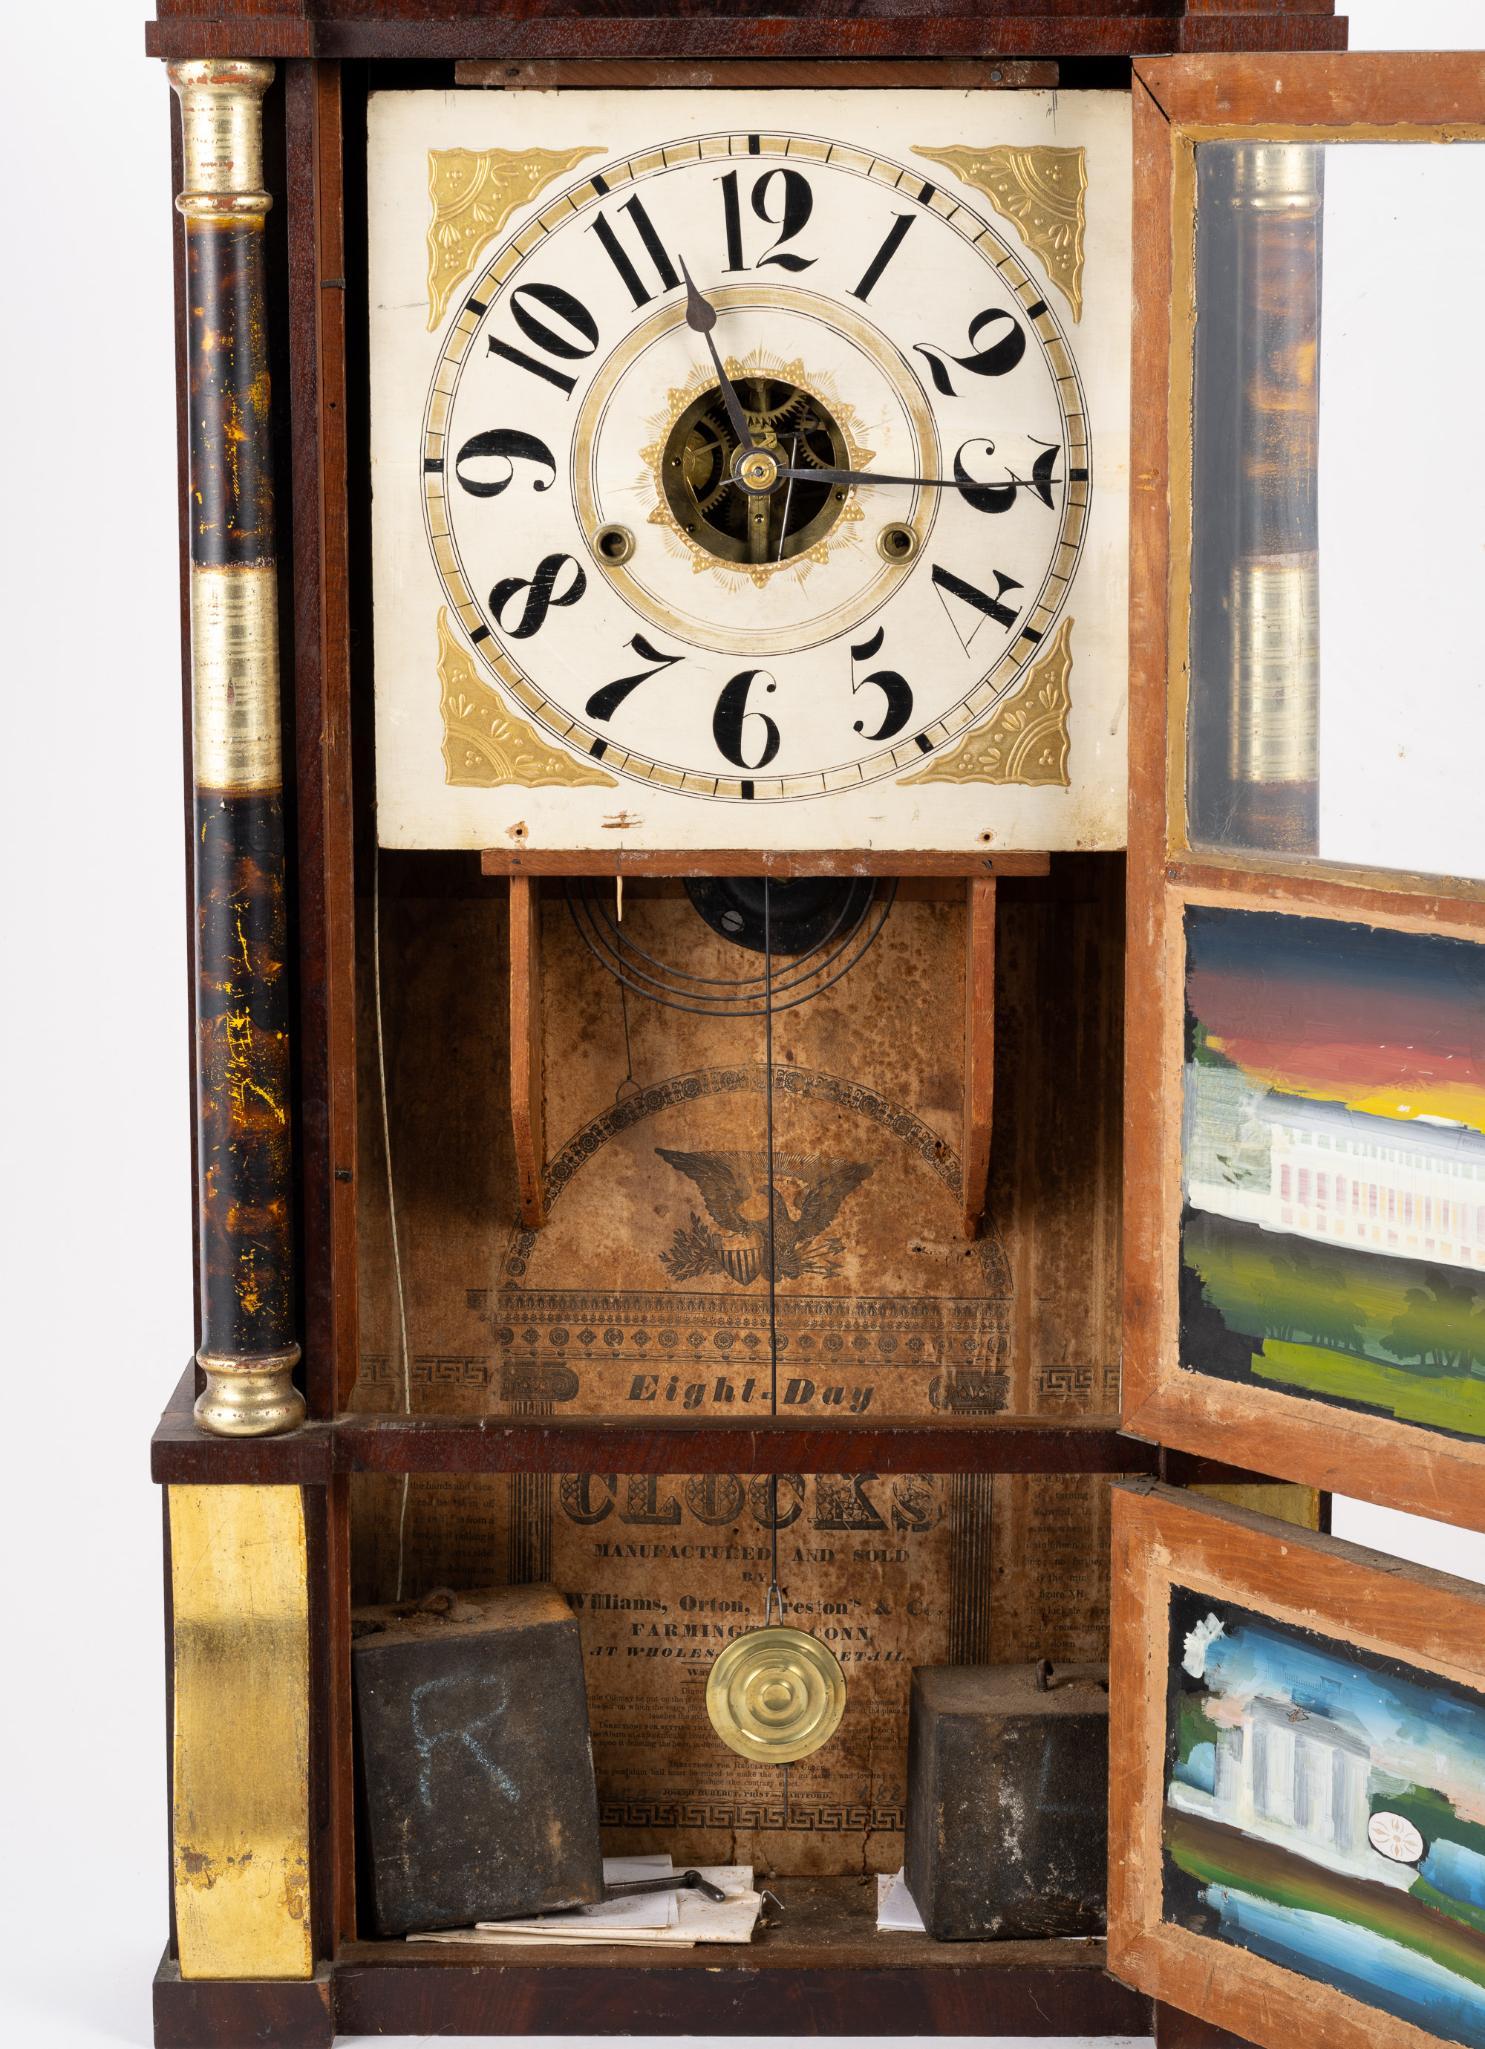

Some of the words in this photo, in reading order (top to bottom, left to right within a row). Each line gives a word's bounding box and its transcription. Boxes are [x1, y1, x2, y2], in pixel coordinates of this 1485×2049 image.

[584, 193, 686, 312] 11
[713, 168, 818, 273] 12
[846, 213, 917, 303] 1
[487, 282, 599, 400] 10
[913, 308, 1026, 397] 2
[456, 428, 556, 498] 9
[952, 435, 1061, 514] 3
[488, 553, 586, 639] 8
[932, 563, 1025, 658] 4
[586, 633, 685, 721] 7
[713, 669, 780, 769] 6
[852, 626, 914, 740] 5
[625, 1374, 876, 1413] Eight-Day
[559, 1473, 945, 1532] CLOCKS
[593, 1543, 772, 1562] MANUFACTURED
[791, 1548, 836, 1562] AND
[852, 1550, 910, 1563] SOLD
[741, 1571, 768, 1583] BY
[678, 1595, 751, 1616] Orton,
[874, 1600, 893, 1616] &
[590, 1645, 619, 1657] AT
[411, 1671, 520, 1810] R
